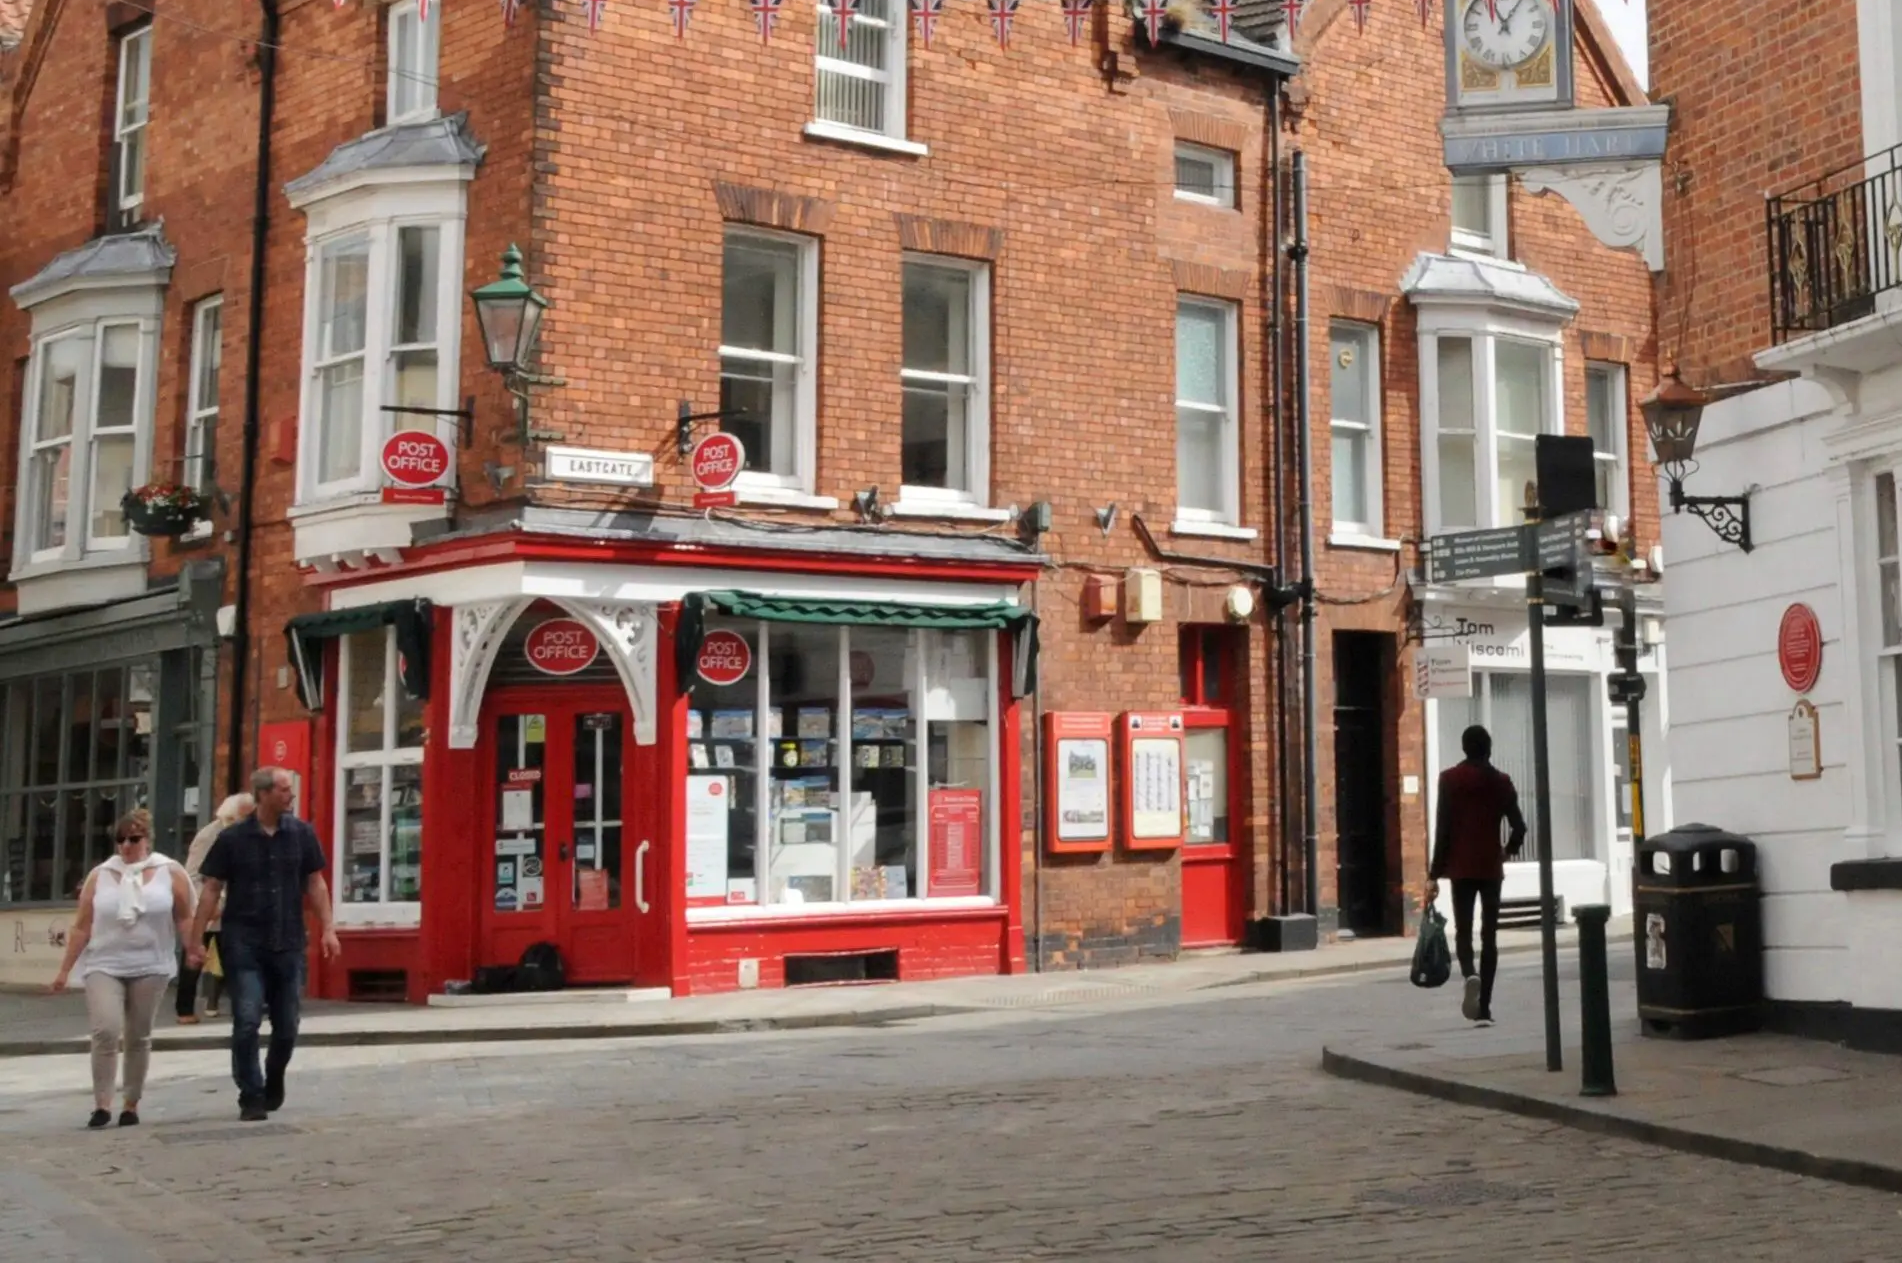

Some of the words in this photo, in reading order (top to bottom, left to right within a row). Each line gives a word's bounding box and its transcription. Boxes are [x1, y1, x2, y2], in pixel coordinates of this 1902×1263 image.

[397, 440, 437, 457] POST
[702, 444, 730, 460] POST
[387, 455, 441, 473] OFFICE
[697, 457, 734, 475] OFFICE
[1456, 617, 1495, 636] Tom
[543, 630, 582, 644] POST
[533, 644, 588, 660] OFFICE
[707, 641, 738, 656] POST
[700, 655, 743, 670] OFFICE
